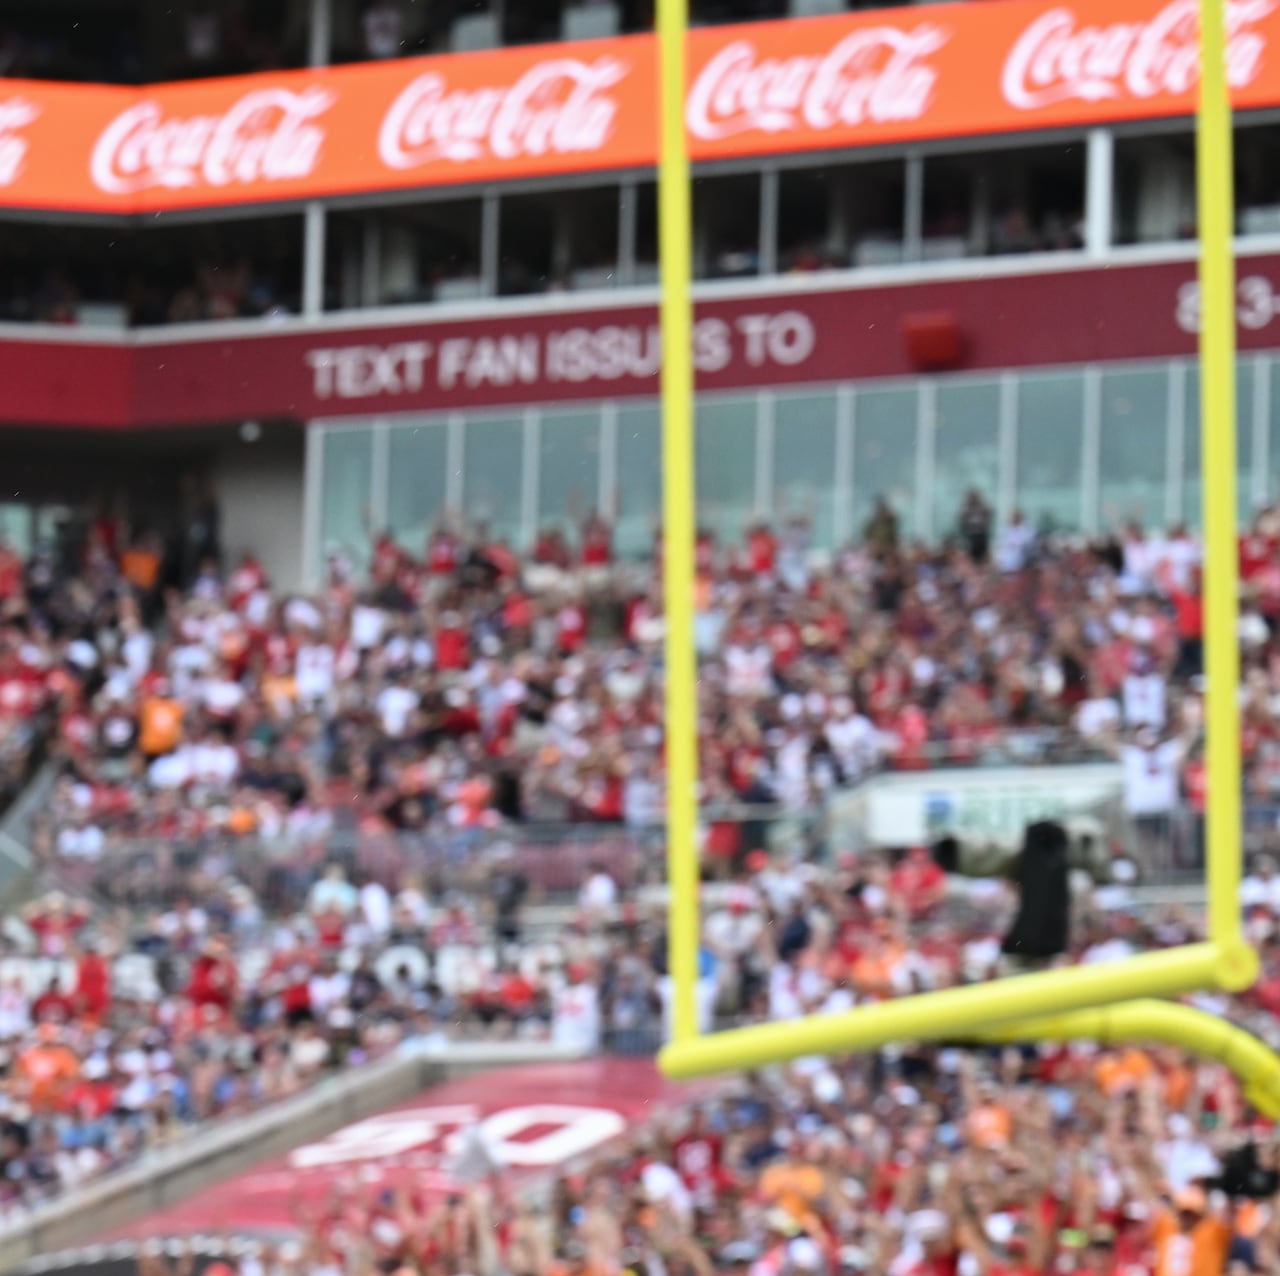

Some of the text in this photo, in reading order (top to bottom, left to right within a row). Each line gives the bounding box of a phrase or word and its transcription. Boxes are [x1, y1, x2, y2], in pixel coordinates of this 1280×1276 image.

[306, 310, 816, 398] TEXT FAN ISSUS TO
